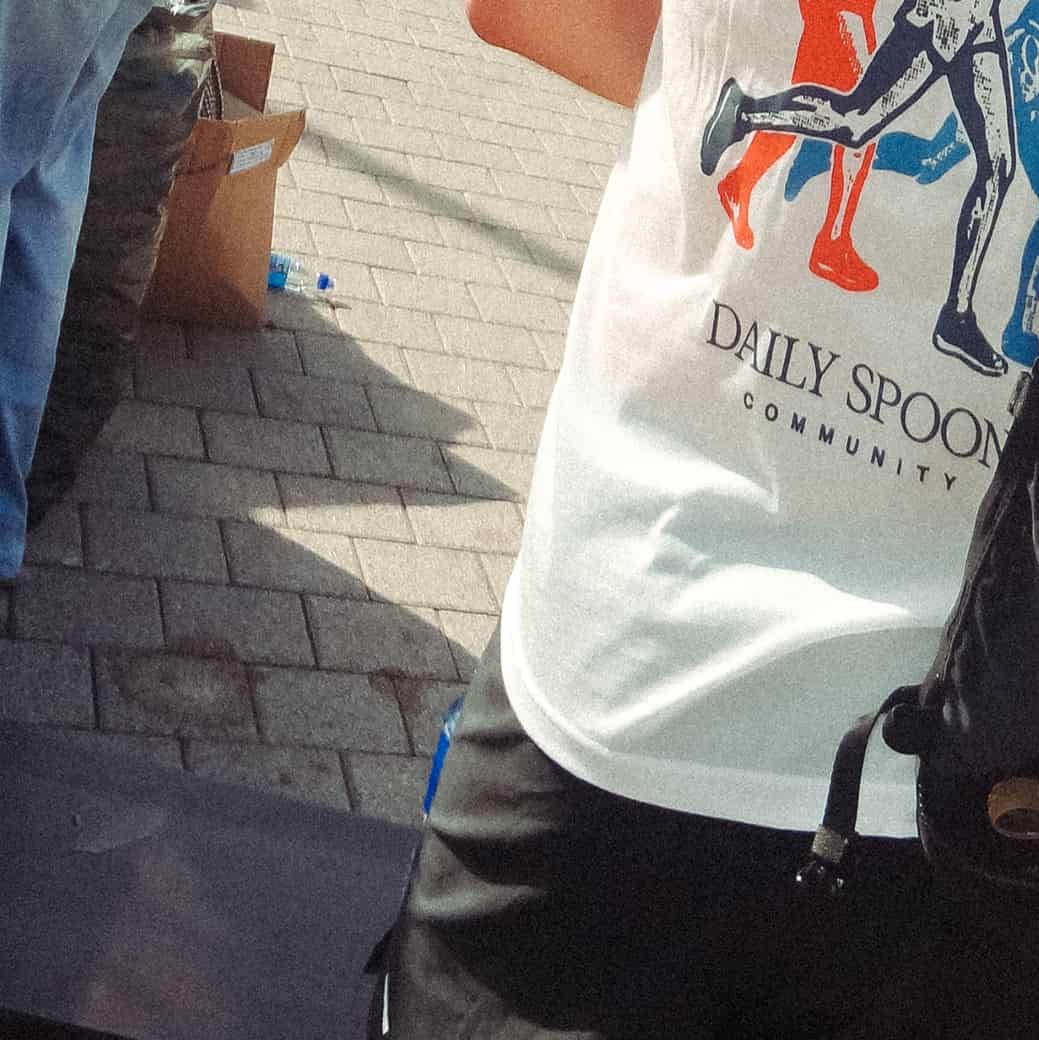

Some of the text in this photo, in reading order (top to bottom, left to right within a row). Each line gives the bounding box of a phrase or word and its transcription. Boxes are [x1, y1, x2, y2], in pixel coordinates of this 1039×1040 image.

[706, 299, 1008, 469] DAILY SPOON
[743, 391, 958, 492] COMMUNITY
